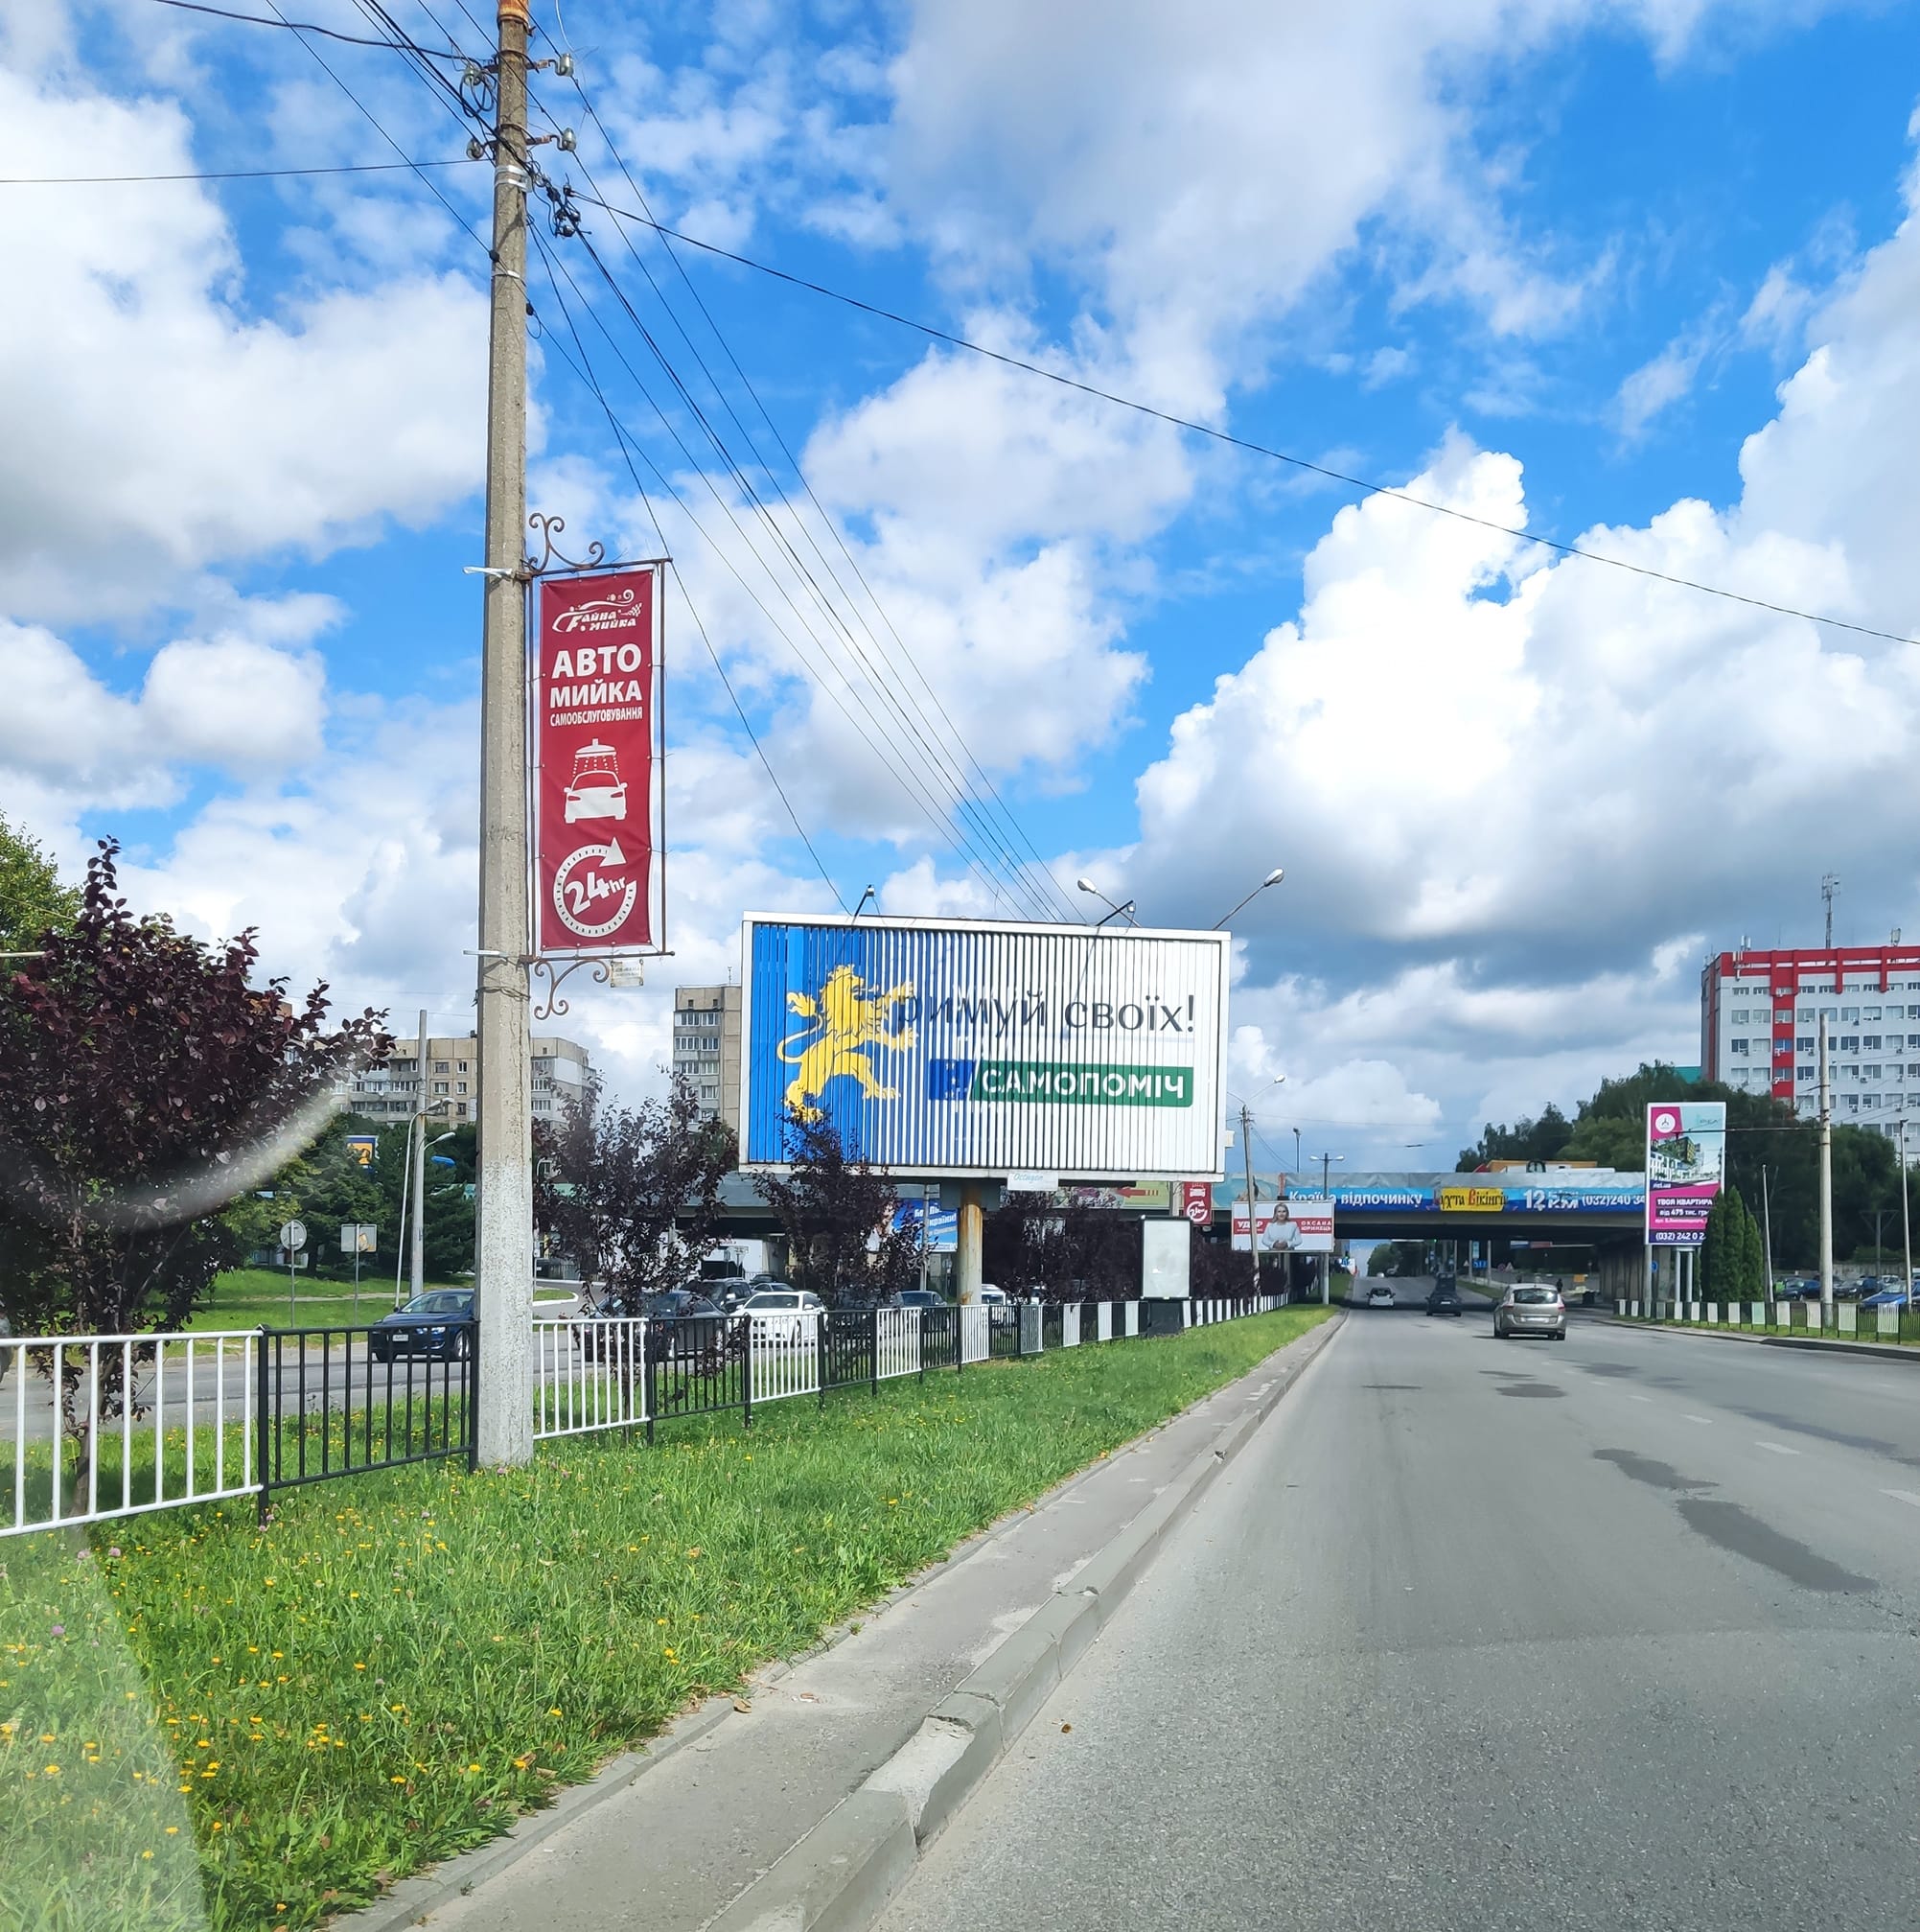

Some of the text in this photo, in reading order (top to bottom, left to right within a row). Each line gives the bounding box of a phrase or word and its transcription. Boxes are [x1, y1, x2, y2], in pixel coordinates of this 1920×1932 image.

[551, 643, 642, 679] АВТО
[549, 680, 642, 709] МИЙКА
[550, 707, 643, 728] САМООБСЛУГОВУВАННЯ
[1064, 994, 1194, 1033] своїх!
[982, 1068, 1184, 1101] САМОПОМІЧ
[1341, 1191, 1423, 1208] відпочинку
[1677, 1198, 1713, 1206] КВАРТИРА
[1238, 1221, 1264, 1229] УДР
[1655, 1232, 1676, 1242] (032)
[1677, 1232, 1691, 1241] 242
